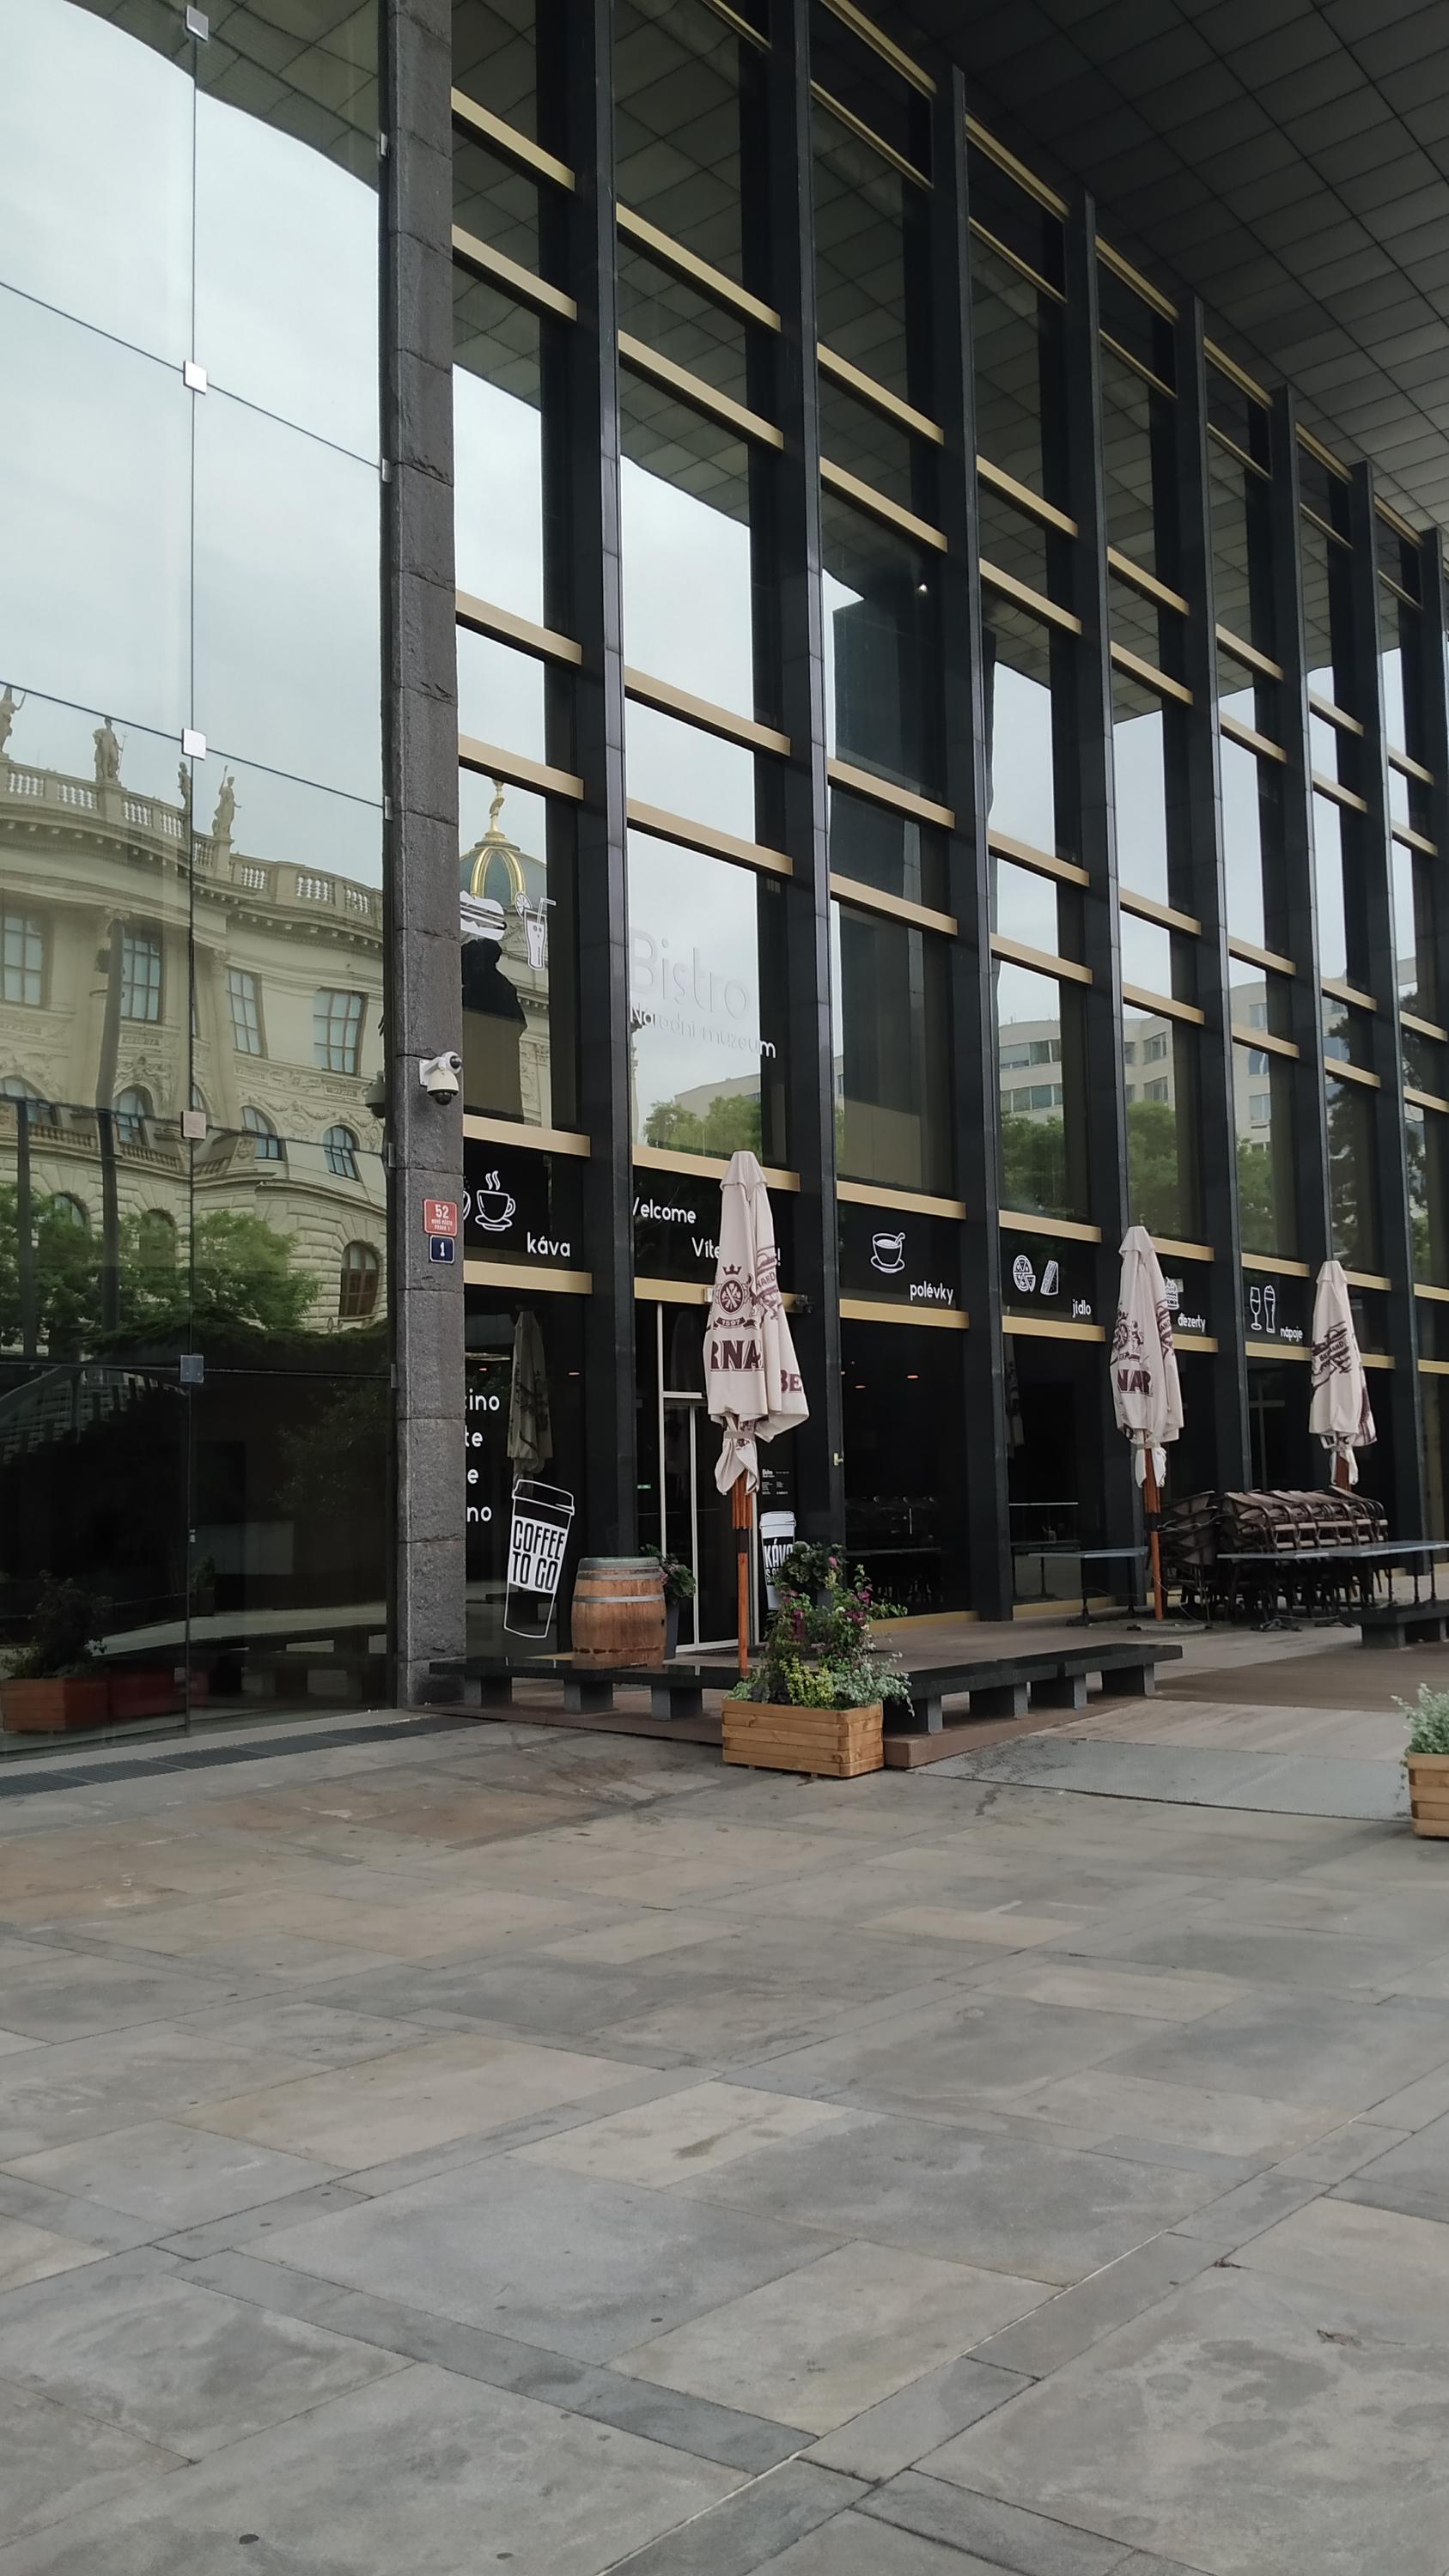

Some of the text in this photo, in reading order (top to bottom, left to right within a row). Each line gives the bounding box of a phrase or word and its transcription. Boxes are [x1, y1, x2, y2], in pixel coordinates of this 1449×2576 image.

[630, 927, 750, 1020] Bistro
[702, 1027, 776, 1059] muzeum
[435, 1204, 449, 1218] 52
[440, 1242, 445, 1257] 1
[527, 1231, 570, 1257] káva
[910, 1280, 953, 1305] polévky
[1072, 1298, 1091, 1318] jídlo
[1178, 1312, 1206, 1333] dezerty
[1280, 1326, 1303, 1342] nápoje
[710, 1340, 761, 1370] RNA
[780, 1370, 802, 1392] BE
[1117, 1369, 1152, 1395] NAR
[513, 1519, 565, 1561] COFFEE
[513, 1550, 558, 1591] TO GO
